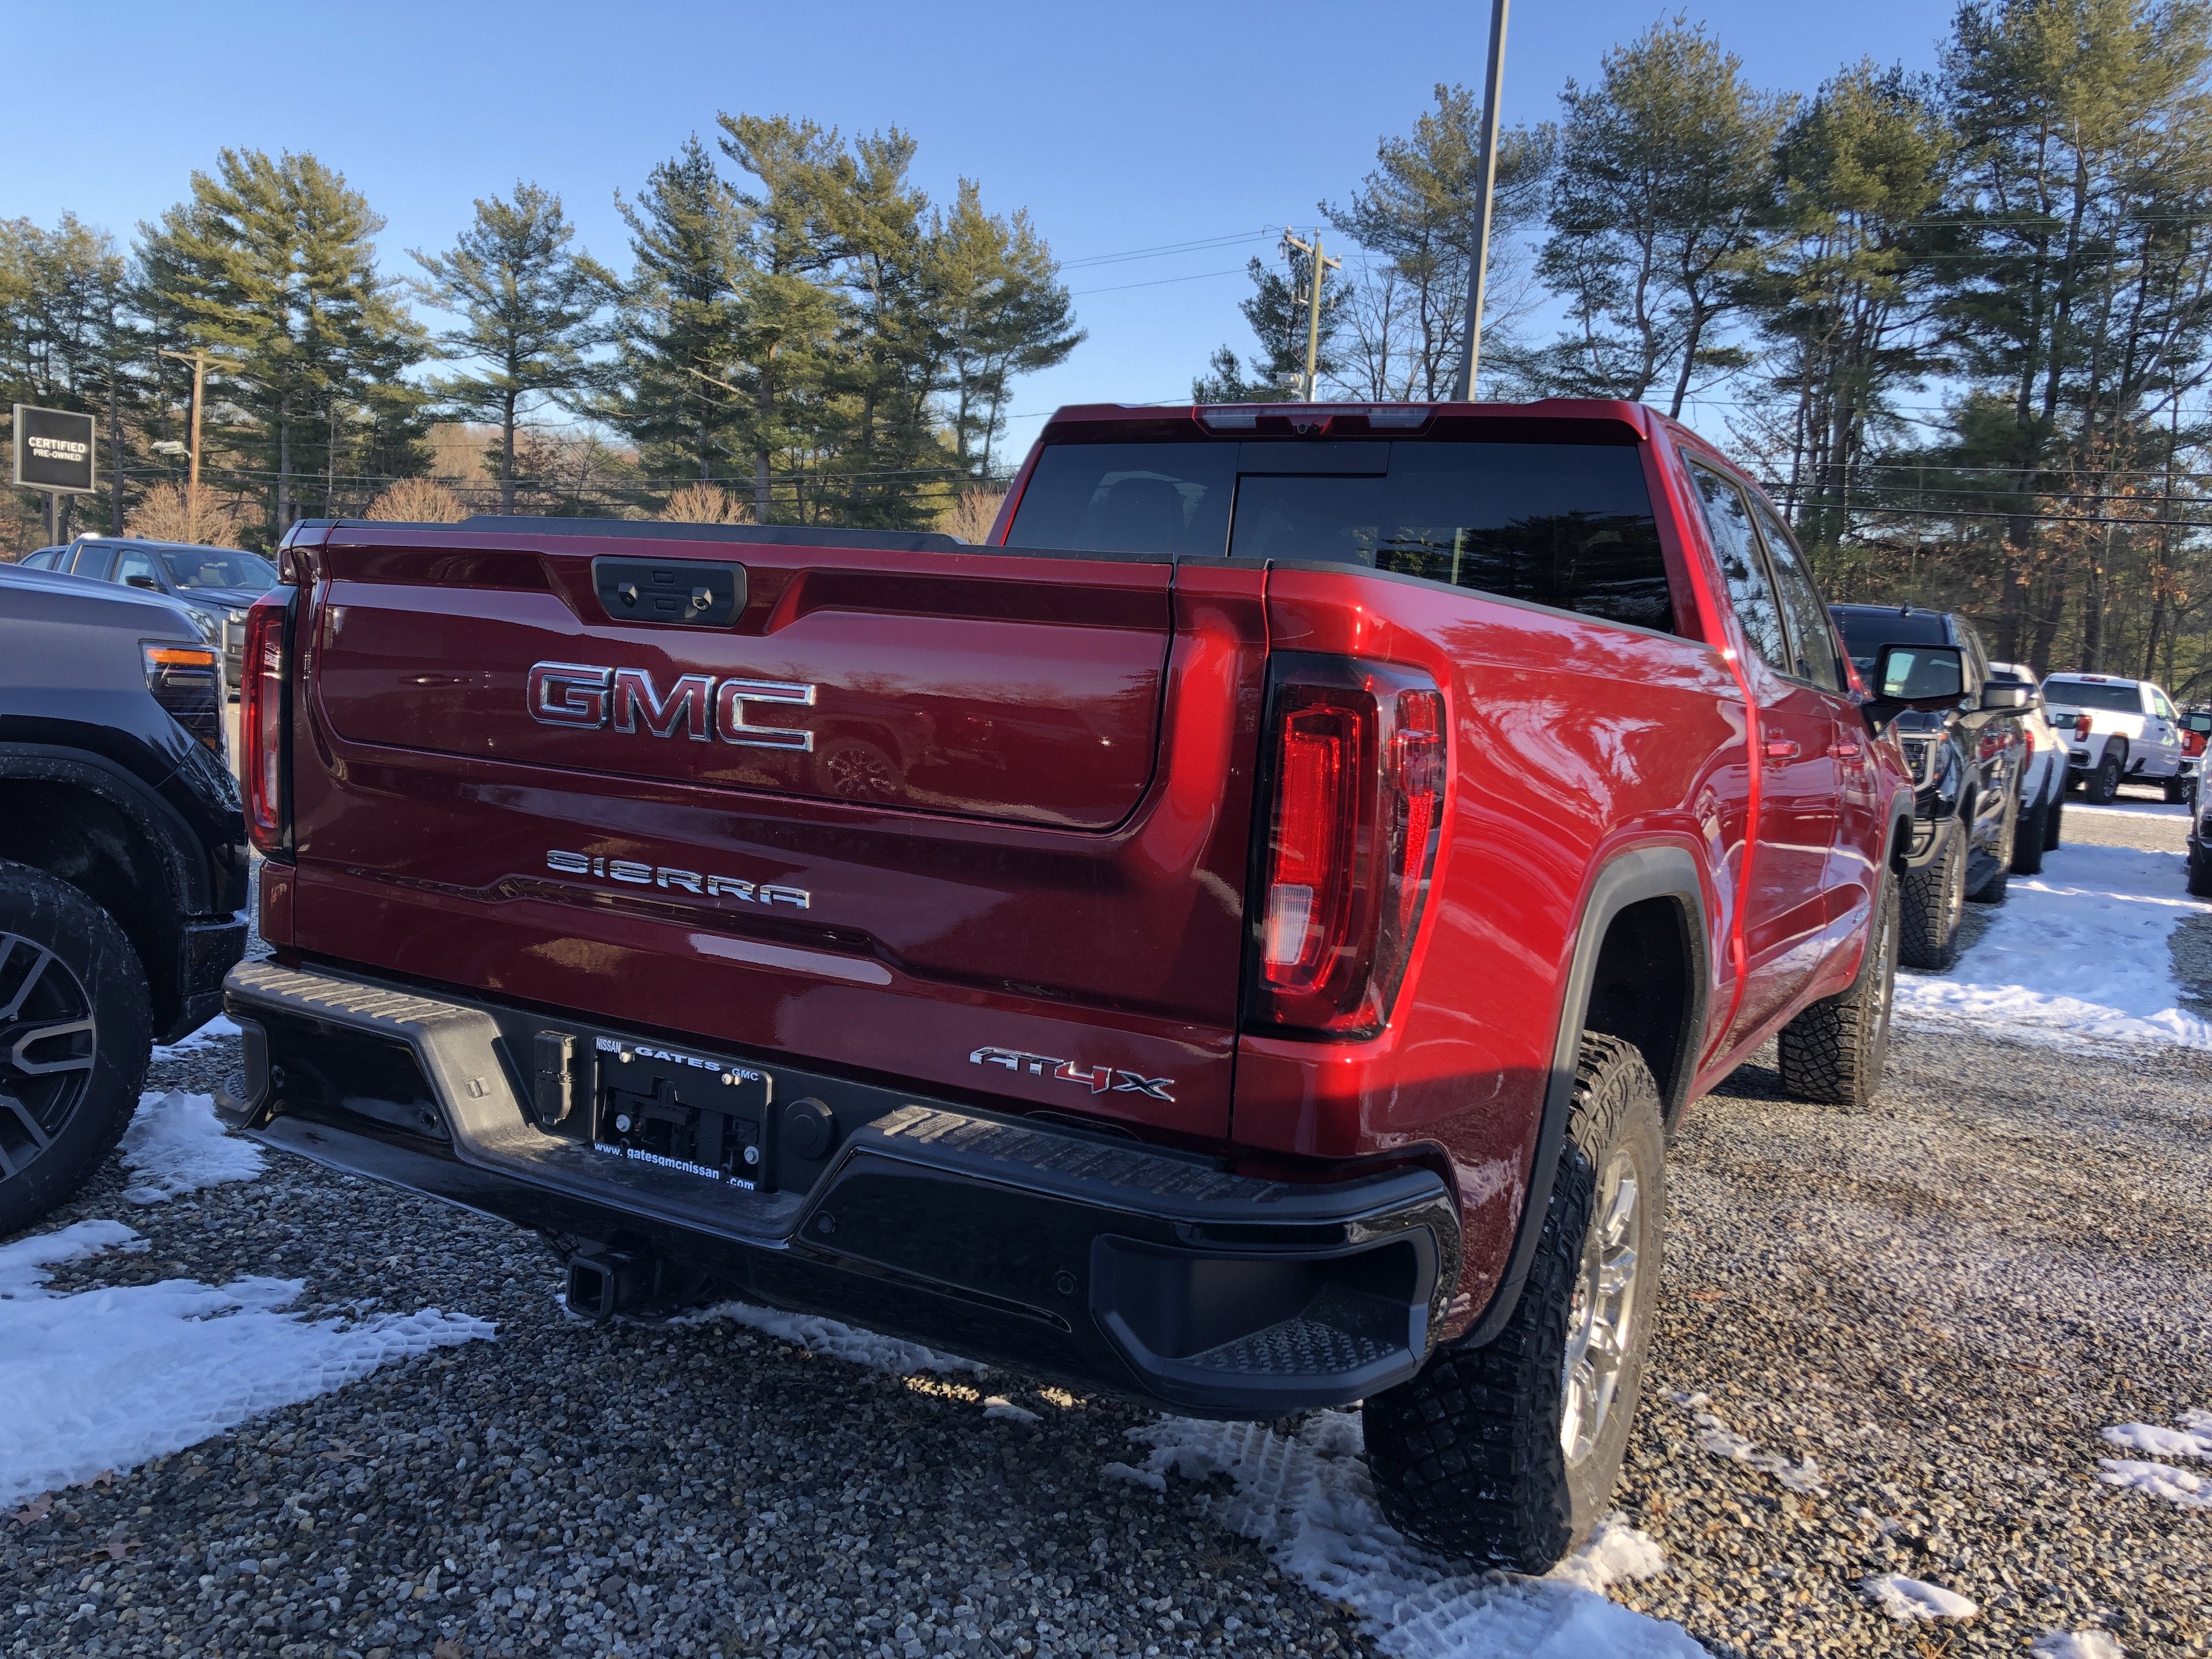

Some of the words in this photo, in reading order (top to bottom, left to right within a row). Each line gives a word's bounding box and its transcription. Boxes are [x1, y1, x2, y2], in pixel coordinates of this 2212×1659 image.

[29, 437, 86, 453] CERTIFIED
[33, 448, 81, 461] PRE-OWNED
[527, 661, 816, 753] GMC
[546, 850, 810, 910] SIERRA
[596, 1037, 621, 1054] NISSAN
[634, 1047, 721, 1071] GATES
[731, 1068, 759, 1081] GMC
[969, 1046, 1176, 1103] AT4X
